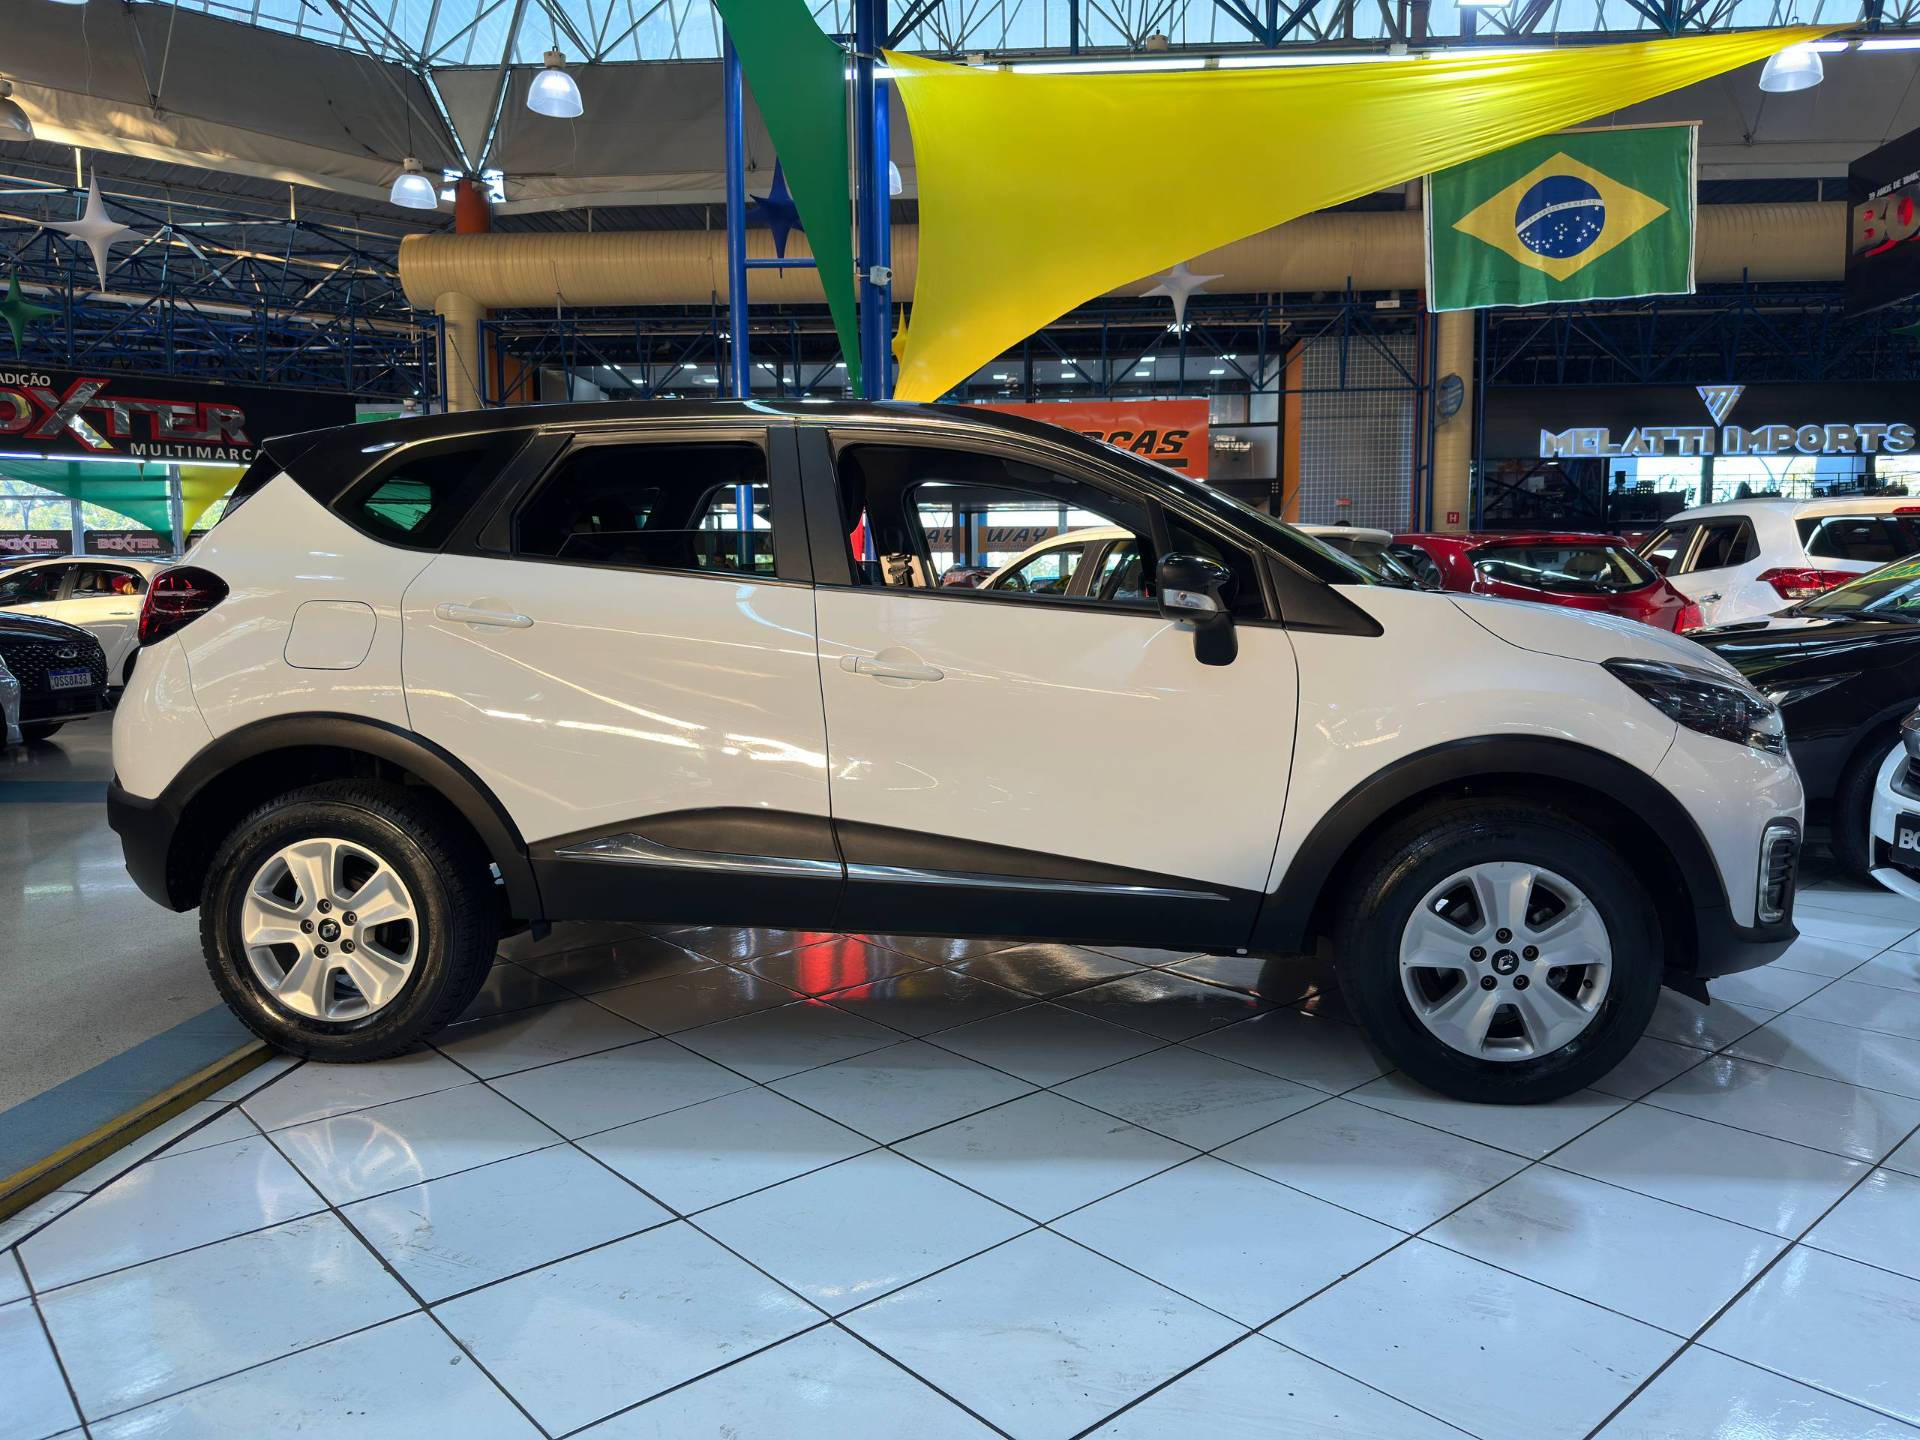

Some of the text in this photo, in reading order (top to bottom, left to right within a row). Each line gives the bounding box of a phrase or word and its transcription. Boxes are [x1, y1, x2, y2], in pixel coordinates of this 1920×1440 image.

[1893, 179, 1902, 190] DE
[1083, 430, 1190, 454] CAS
[1540, 423, 1916, 457] MELATTI IMPORTS
[97, 534, 160, 553] BOXTER
[986, 528, 1048, 542] WAY
